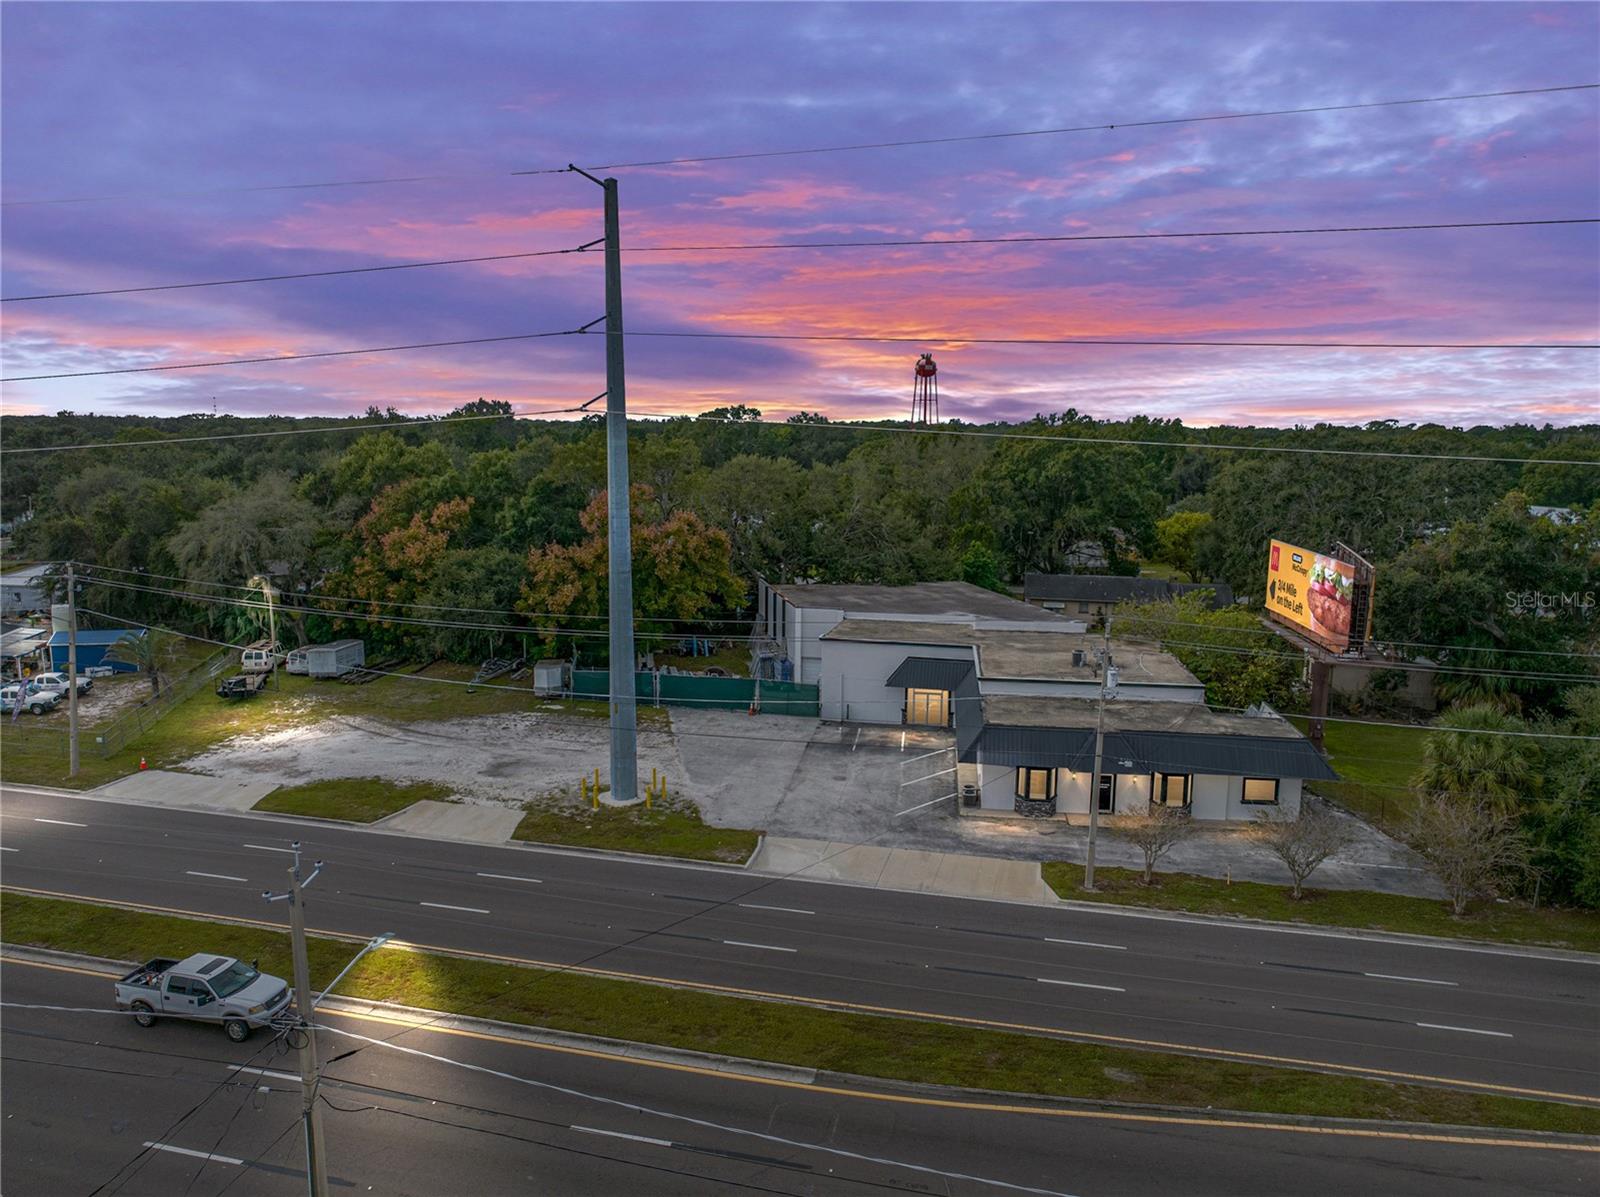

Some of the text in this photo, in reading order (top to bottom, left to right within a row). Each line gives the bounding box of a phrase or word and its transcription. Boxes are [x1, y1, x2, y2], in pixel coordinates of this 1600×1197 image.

[1278, 579, 1297, 598] 3/4 Mile
[1277, 595, 1303, 616] on the Left
